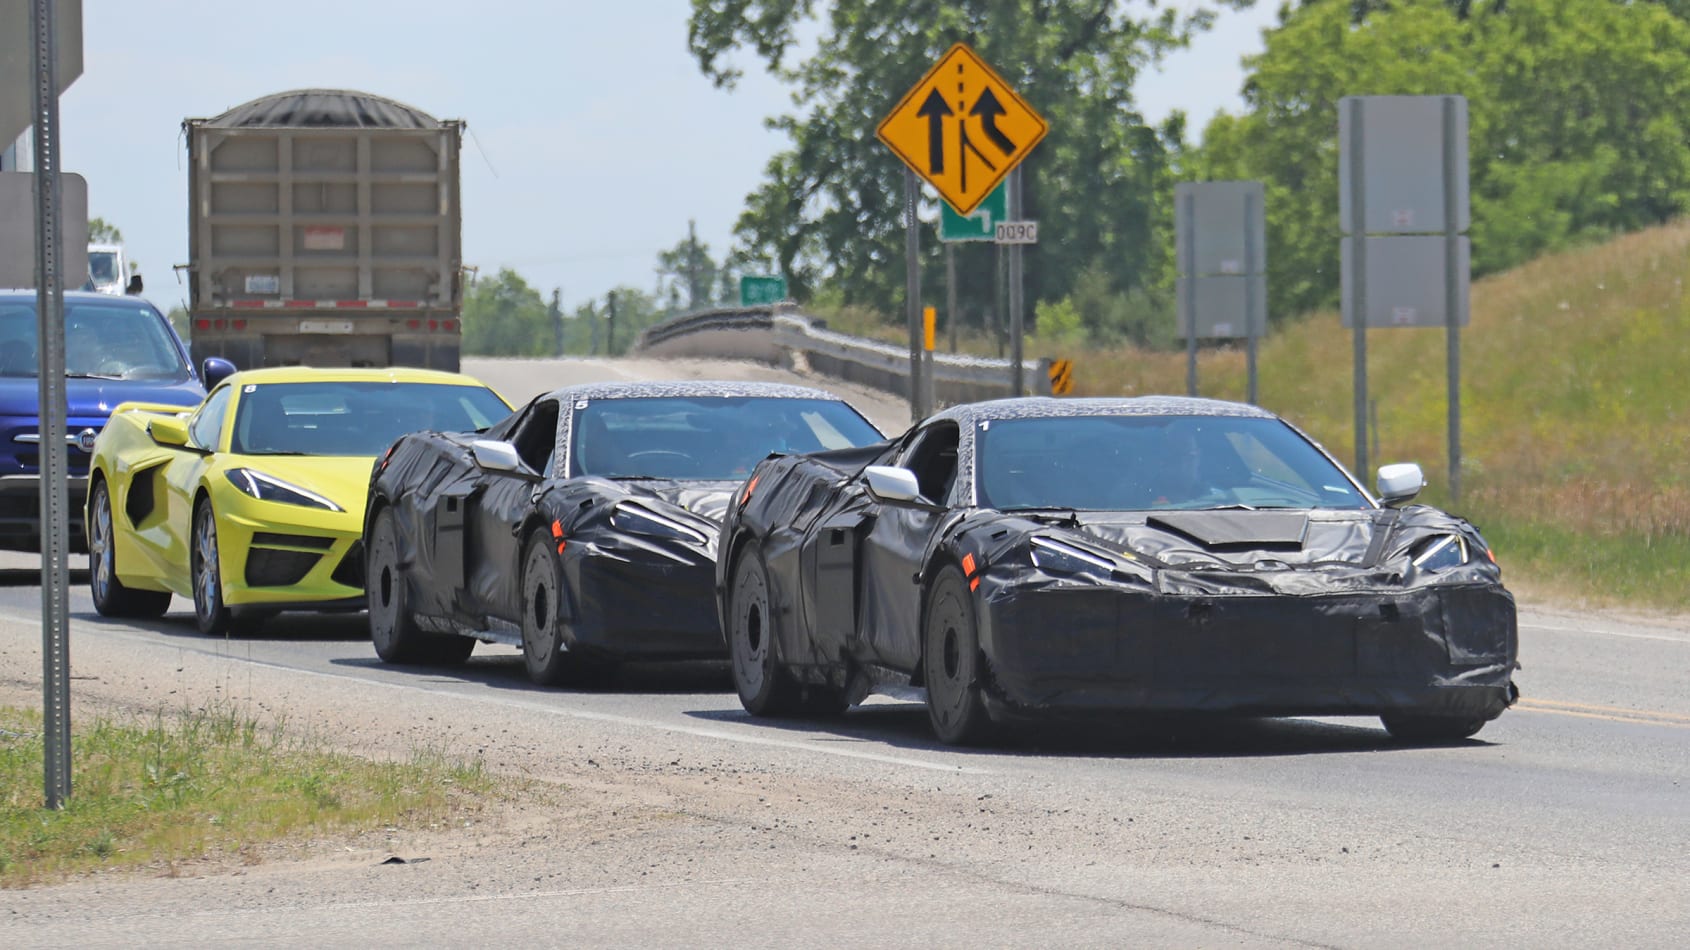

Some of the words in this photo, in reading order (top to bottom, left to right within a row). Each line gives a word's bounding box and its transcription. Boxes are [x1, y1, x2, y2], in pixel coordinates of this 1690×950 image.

[245, 385, 256, 393] 8
[575, 400, 588, 409] 5
[979, 420, 989, 431] 1
